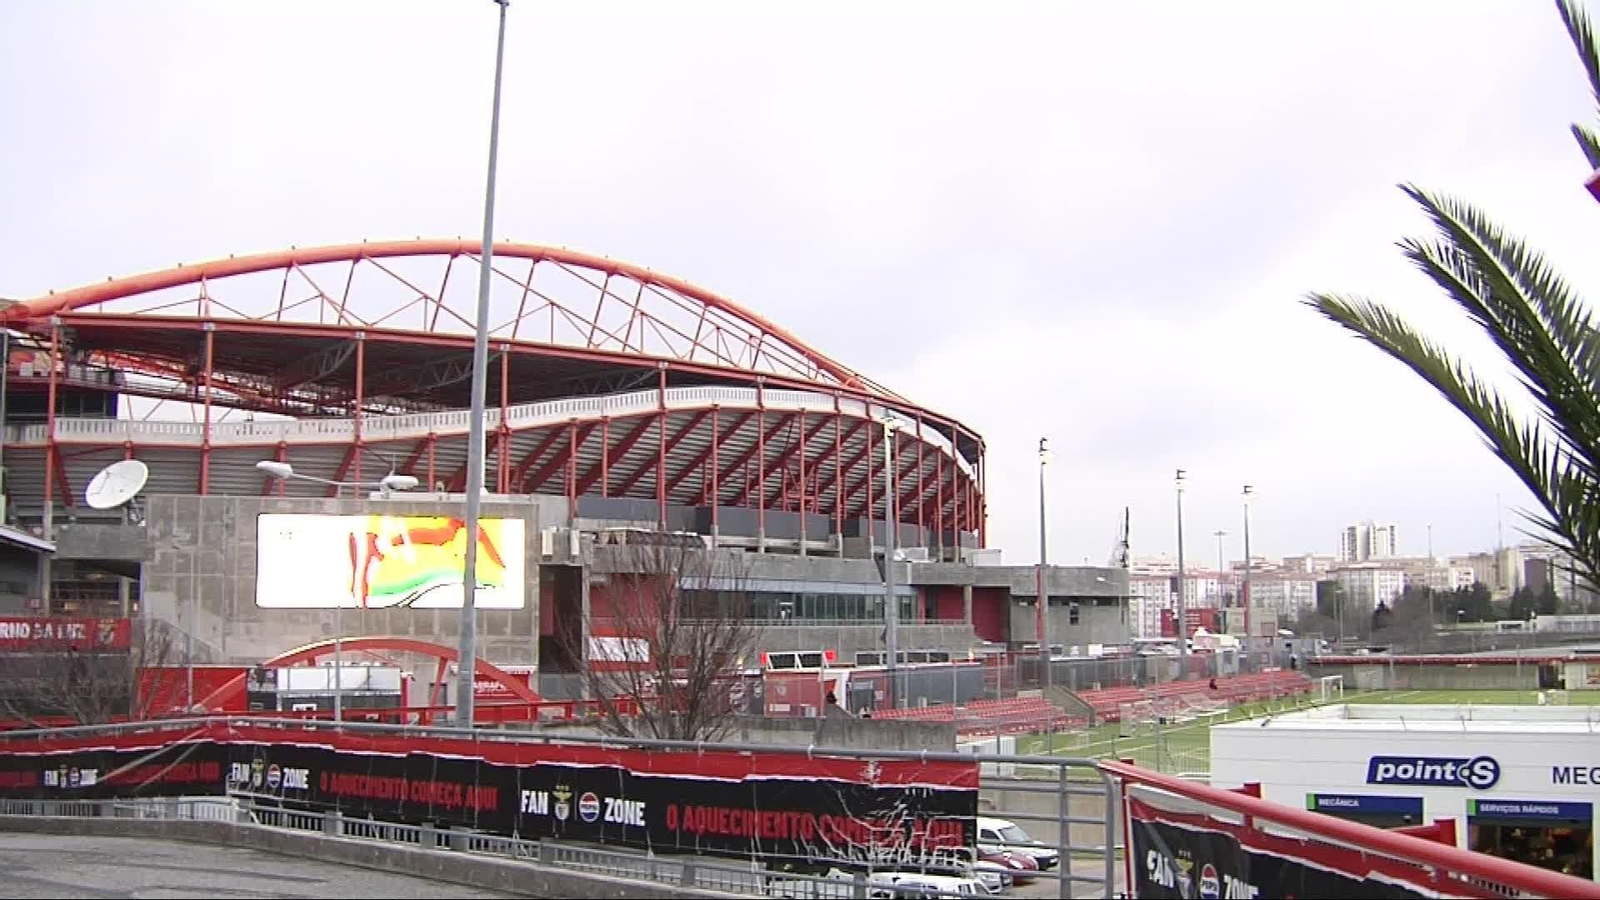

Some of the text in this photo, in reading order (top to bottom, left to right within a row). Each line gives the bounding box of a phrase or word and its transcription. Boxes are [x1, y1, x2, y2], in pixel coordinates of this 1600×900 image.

[231, 762, 250, 783] FAN
[283, 767, 309, 789] ZONE
[1376, 760, 1457, 781] point
[521, 790, 549, 815] FAN
[604, 797, 646, 827] ZONE
[667, 804, 677, 830] O
[682, 805, 816, 840] AQUECIMENTO
[1480, 803, 1559, 814] SERVIÇOS RÁPIDOS
[1147, 849, 1174, 888] FAN
